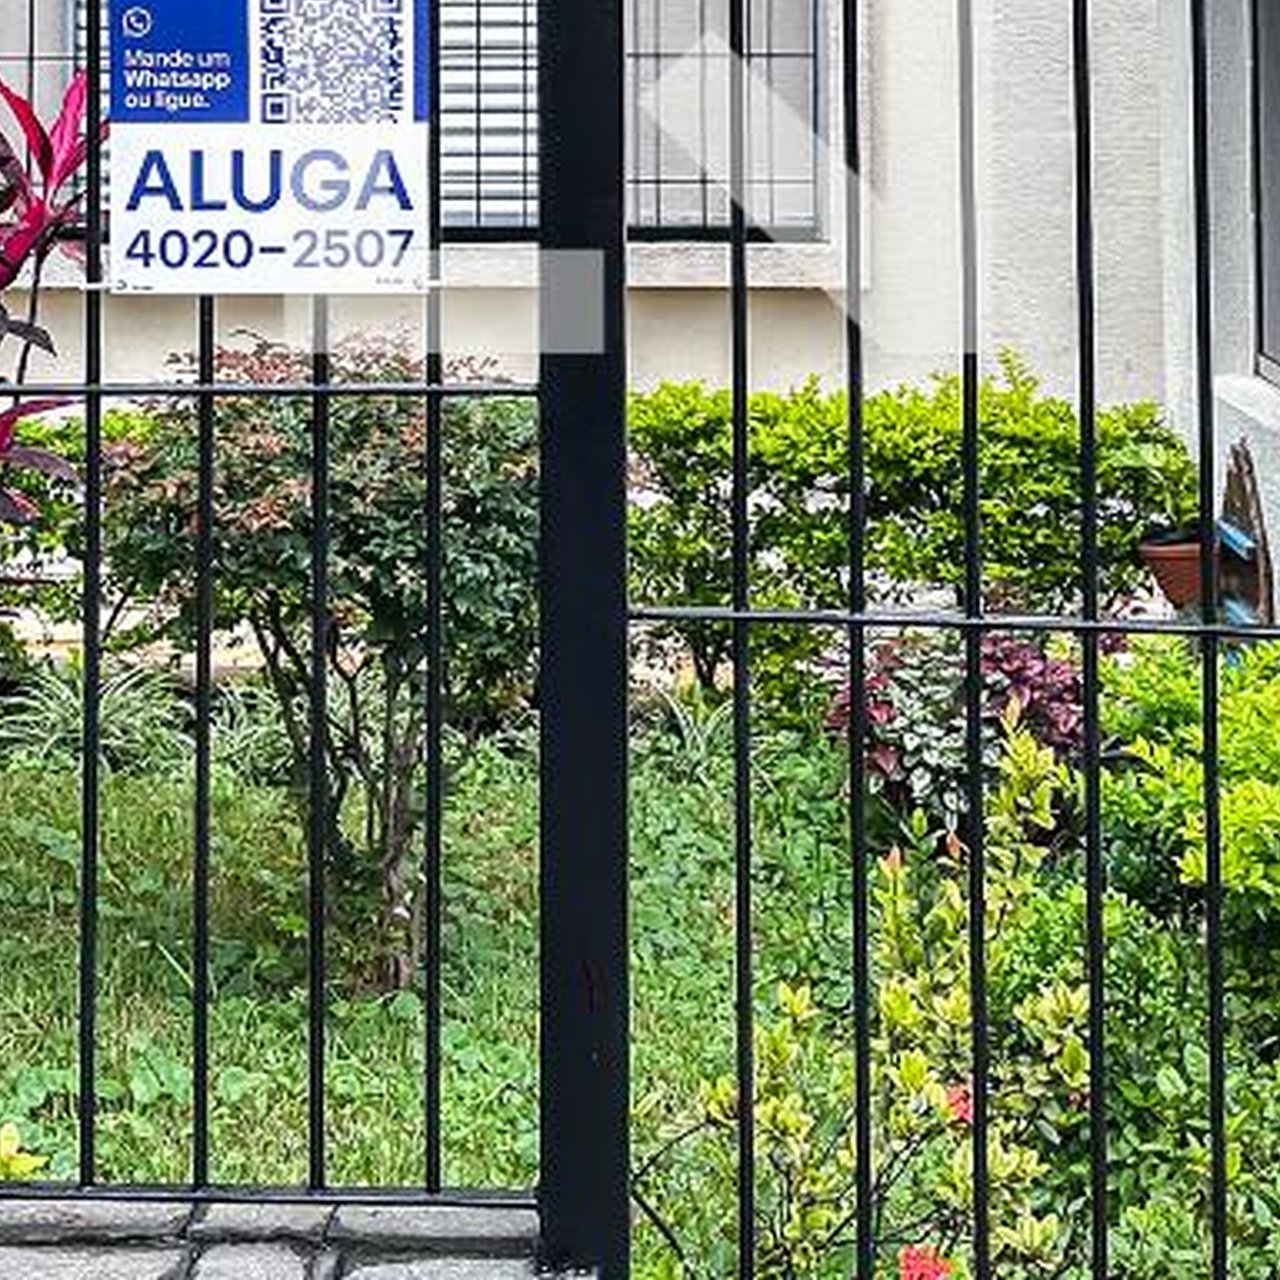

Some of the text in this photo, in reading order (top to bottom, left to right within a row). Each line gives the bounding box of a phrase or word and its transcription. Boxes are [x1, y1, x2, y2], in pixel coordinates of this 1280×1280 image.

[124, 48, 232, 68] Mande um
[122, 69, 232, 91] Whatsapp
[124, 89, 212, 113] ou ligue.
[124, 148, 415, 214] ALUGA
[125, 228, 415, 270] 4020-2507
